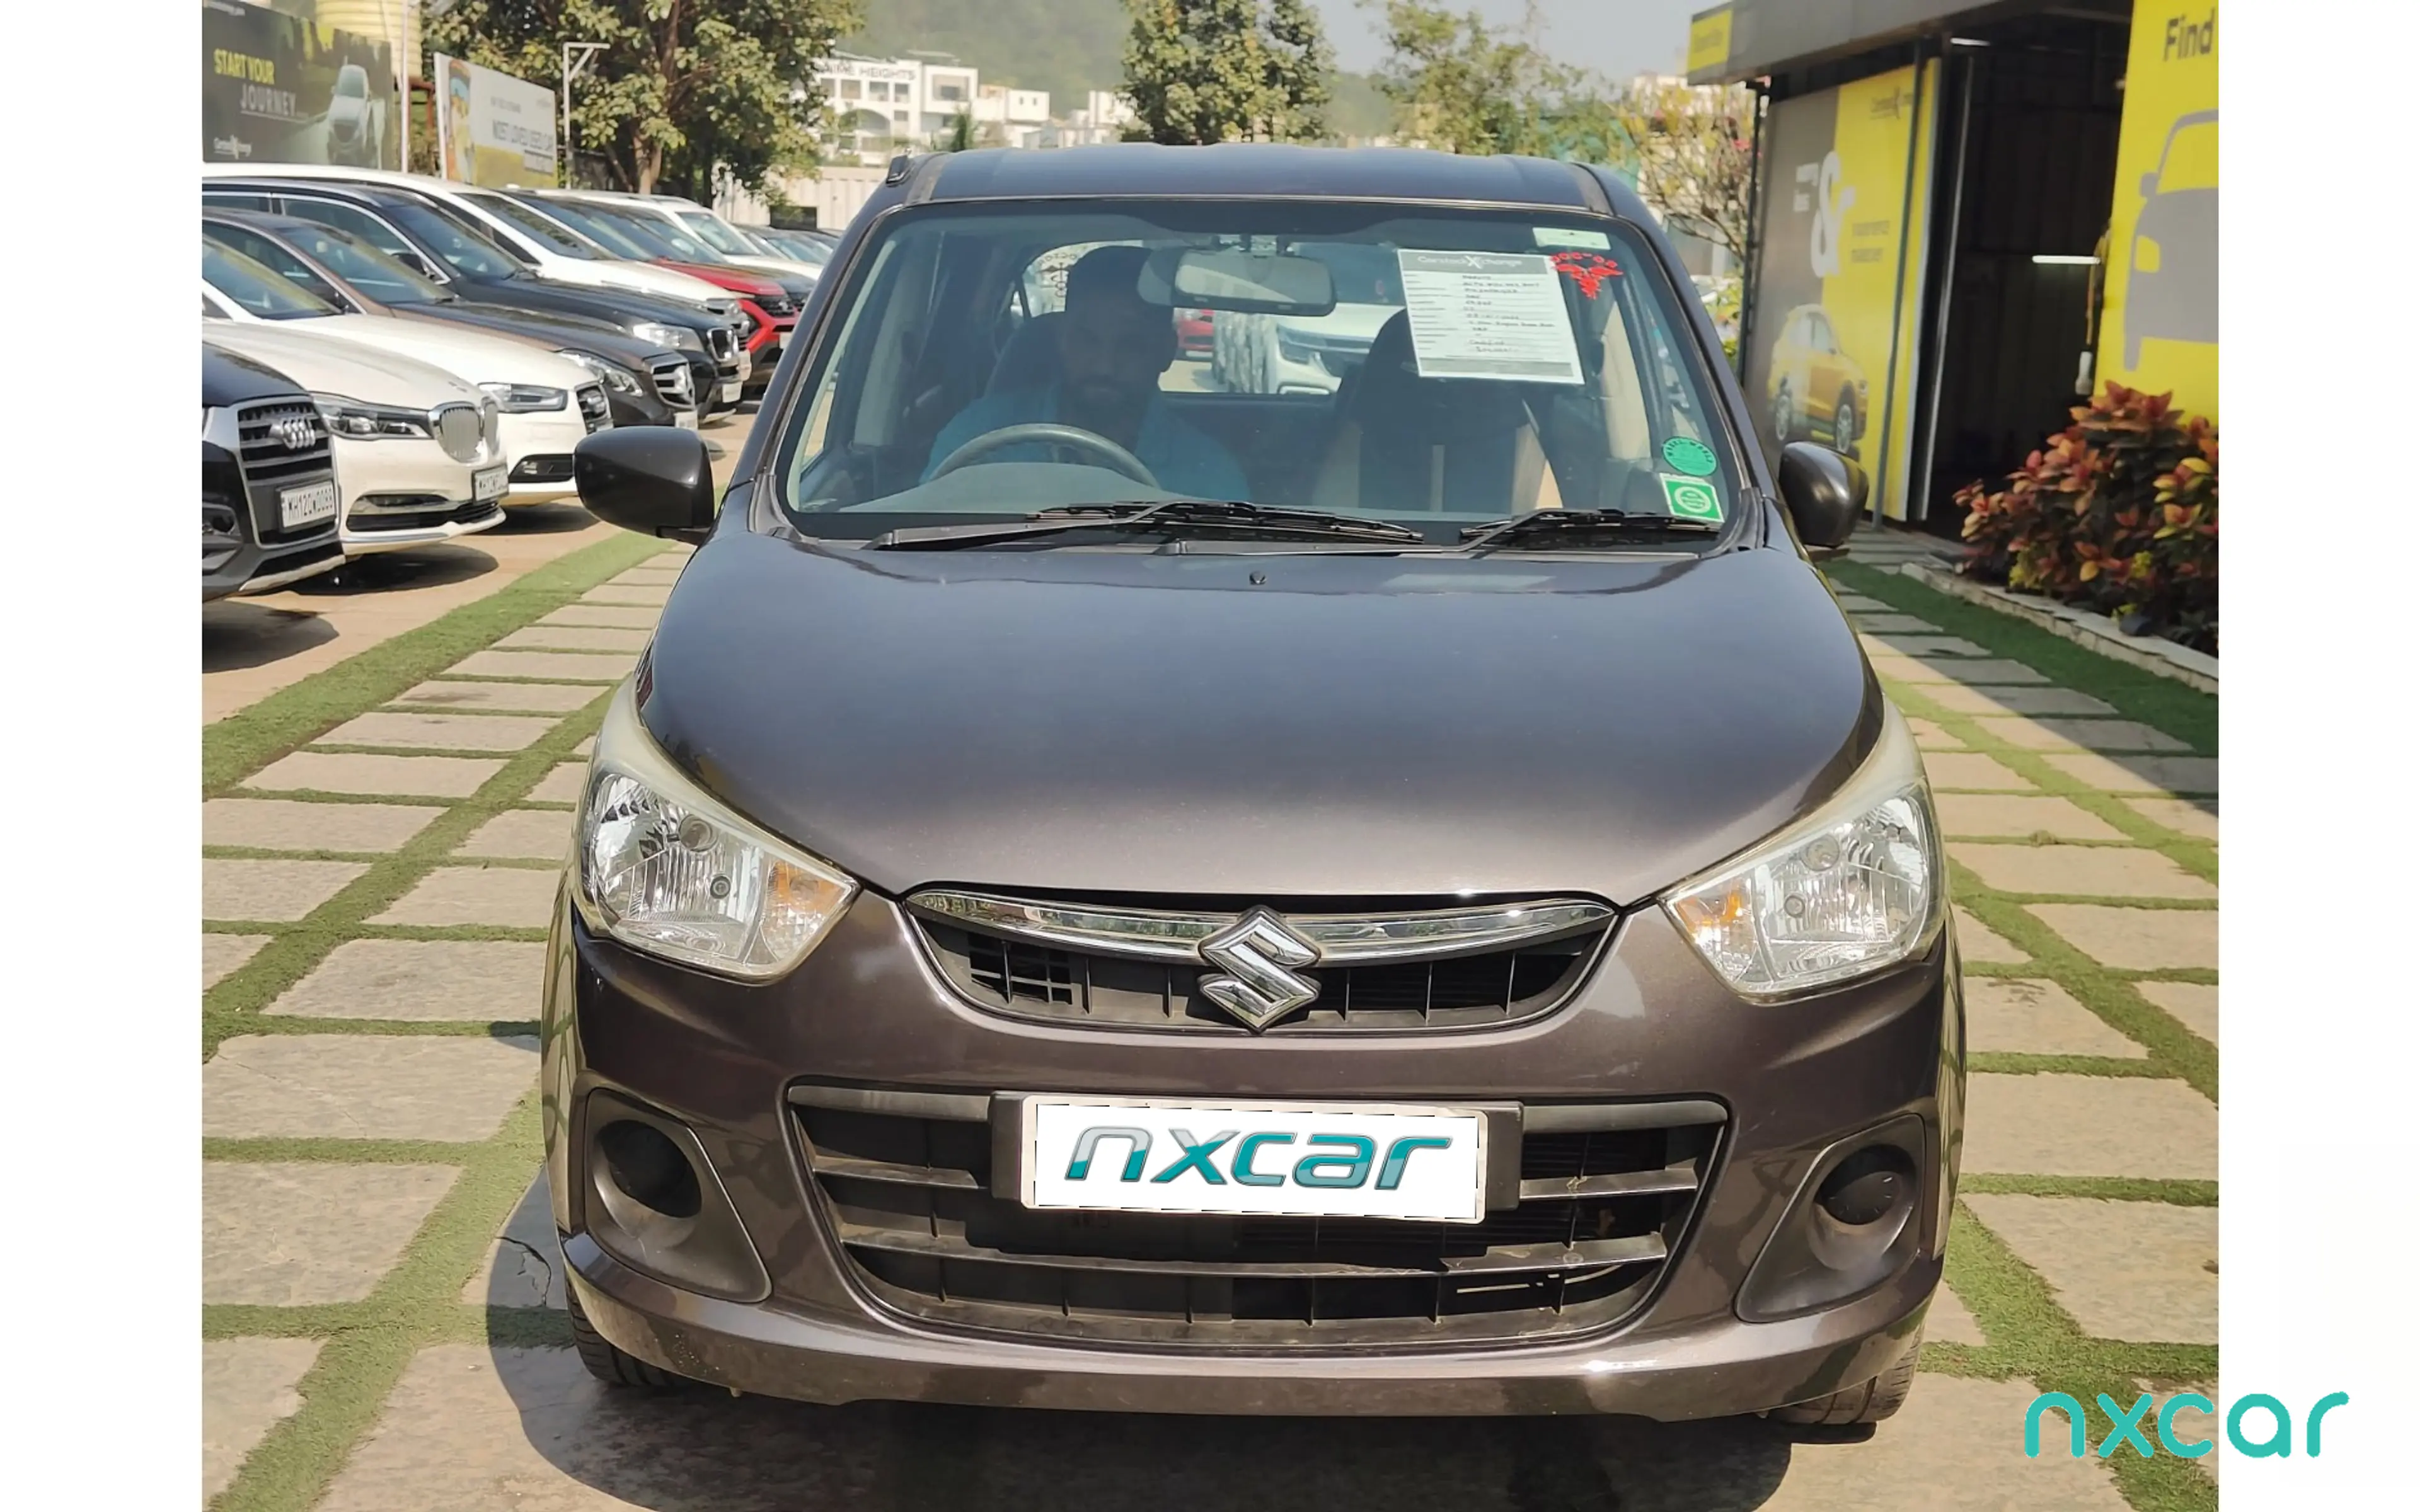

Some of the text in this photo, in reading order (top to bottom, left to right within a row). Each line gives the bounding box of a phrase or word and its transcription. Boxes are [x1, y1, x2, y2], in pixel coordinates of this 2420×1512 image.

[2163, 6, 2215, 62] Find
[214, 48, 275, 85] START YOUR
[1811, 150, 1856, 278] &
